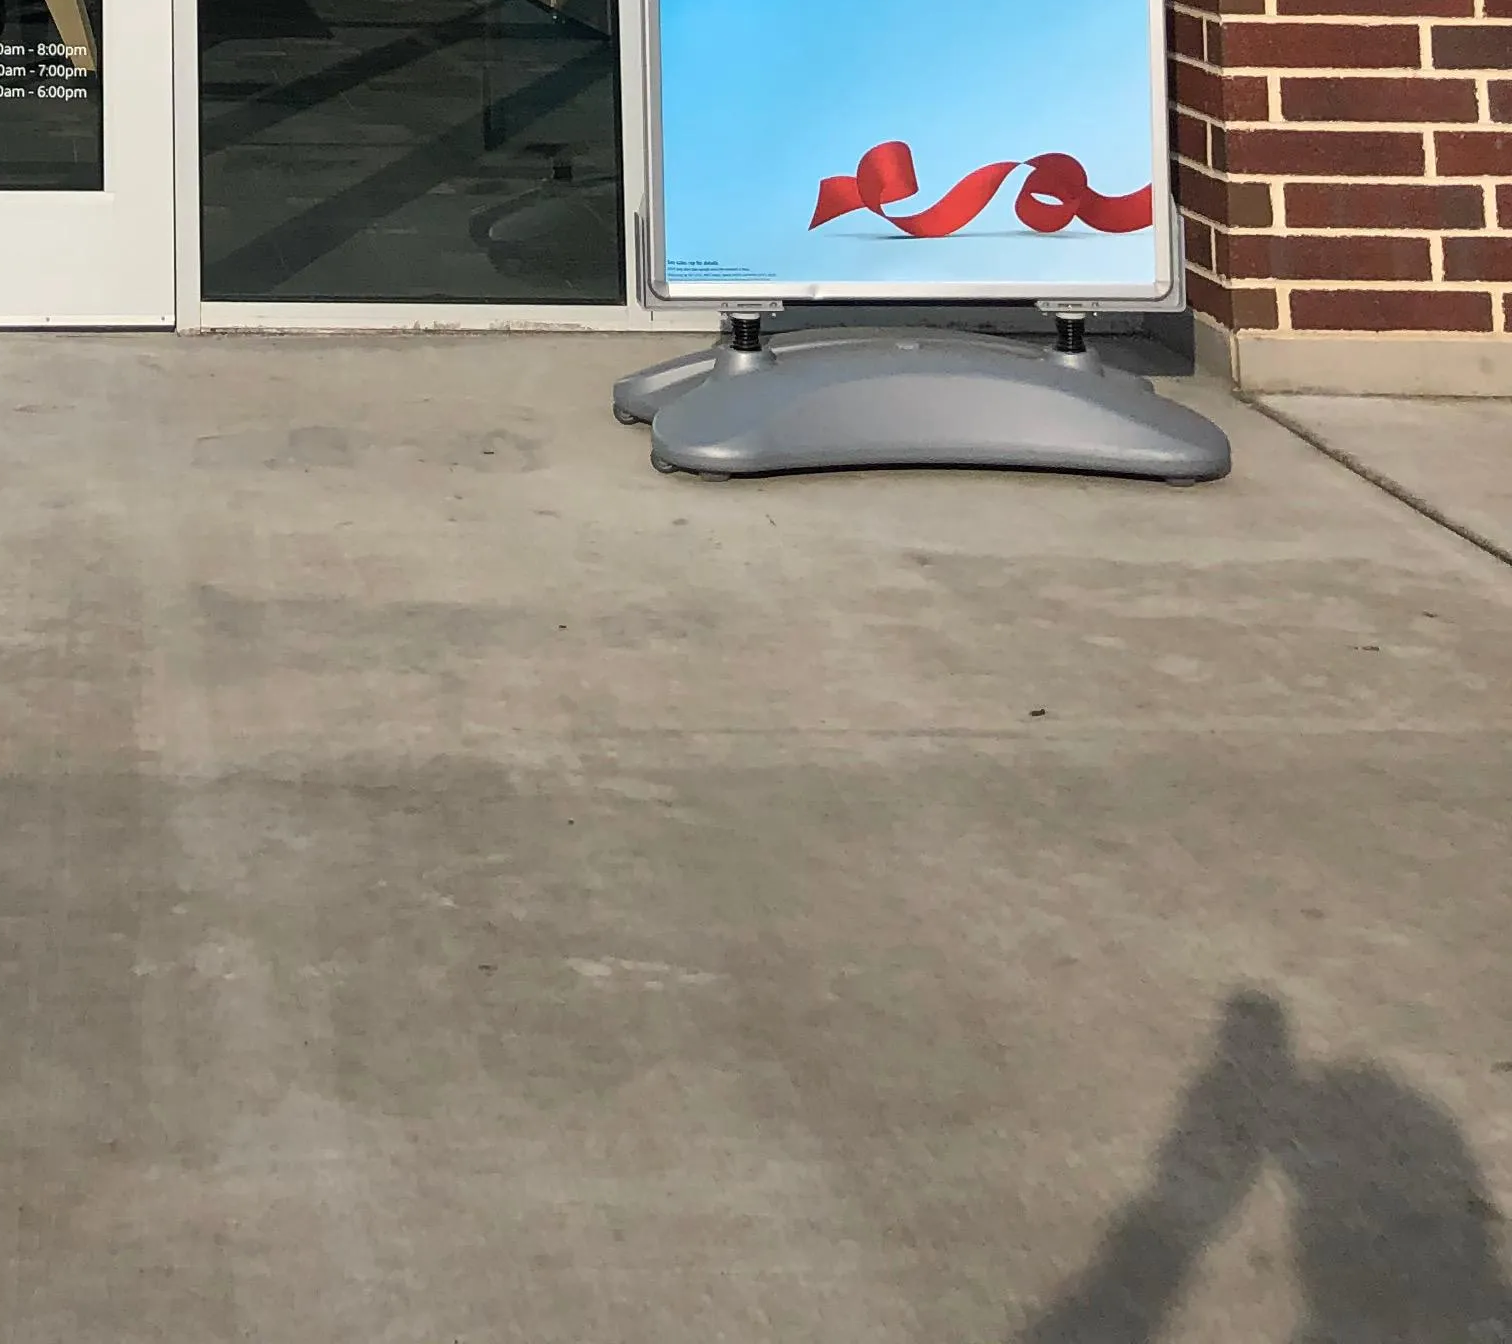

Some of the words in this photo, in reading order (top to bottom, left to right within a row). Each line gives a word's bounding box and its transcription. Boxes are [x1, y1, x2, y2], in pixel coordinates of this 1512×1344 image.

[37, 43, 87, 60] 8:00pm
[38, 64, 87, 80] 7:00pm
[37, 85, 87, 101] 6:00pm
